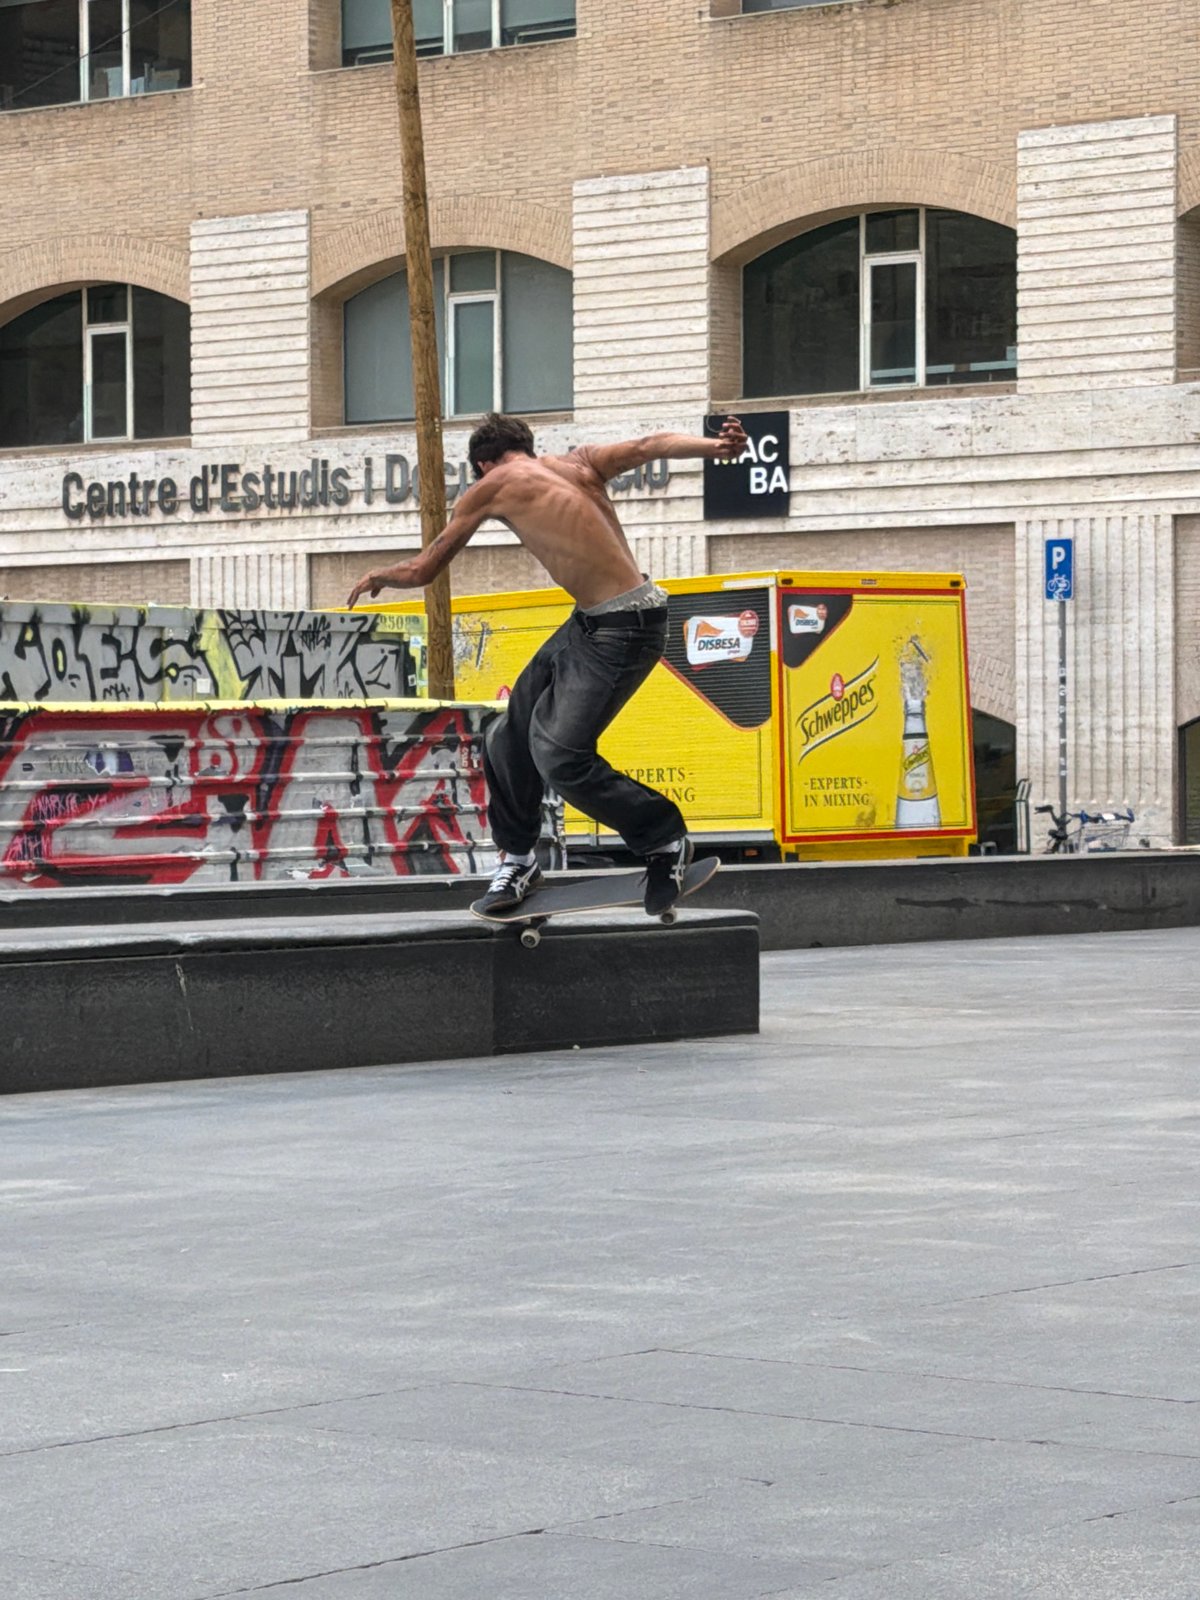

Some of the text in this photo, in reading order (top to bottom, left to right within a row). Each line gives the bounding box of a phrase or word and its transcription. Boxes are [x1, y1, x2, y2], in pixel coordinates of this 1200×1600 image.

[713, 434, 778, 465] AC
[62, 472, 178, 519] Centre
[190, 458, 350, 512] d'Estudis
[364, 457, 373, 505] i
[749, 466, 788, 494] BA
[1052, 546, 1066, 570] P
[697, 637, 740, 651] DISBESA
[800, 678, 875, 747] Schweppes
[804, 793, 870, 807] IN MIXING
